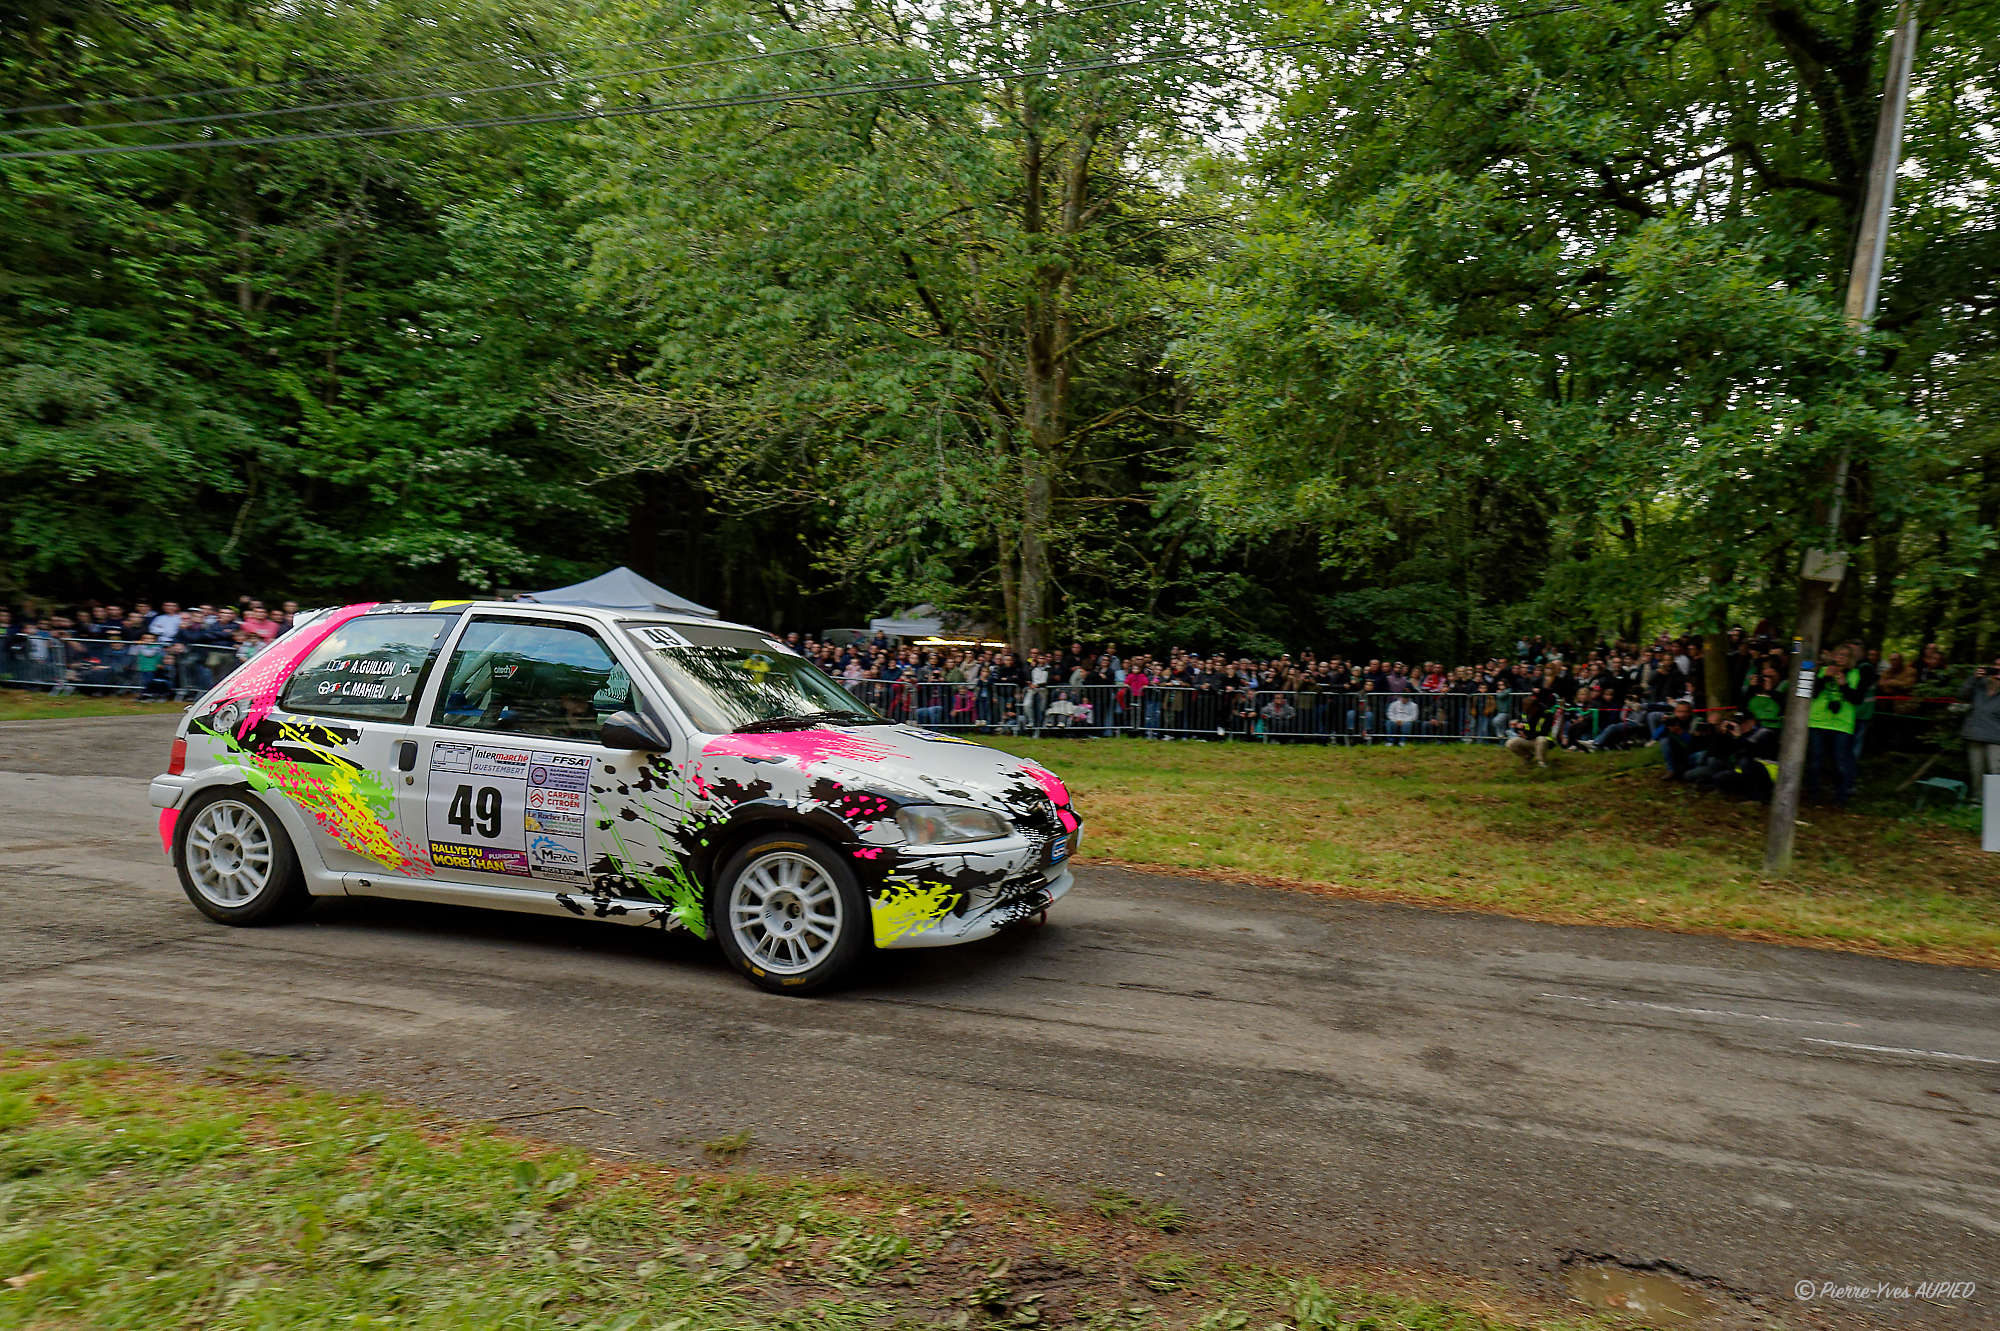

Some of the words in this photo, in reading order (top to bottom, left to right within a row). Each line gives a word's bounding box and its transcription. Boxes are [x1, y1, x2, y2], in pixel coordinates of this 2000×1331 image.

[643, 628, 682, 646] 49
[350, 660, 396, 675] A.GUILLON
[552, 756, 584, 766] FFSA
[473, 763, 526, 775] QUESTEMBERT
[547, 790, 580, 800] CARPIER
[448, 784, 503, 838] 49
[431, 843, 468, 856] RALLYE
[468, 847, 483, 857] DU
